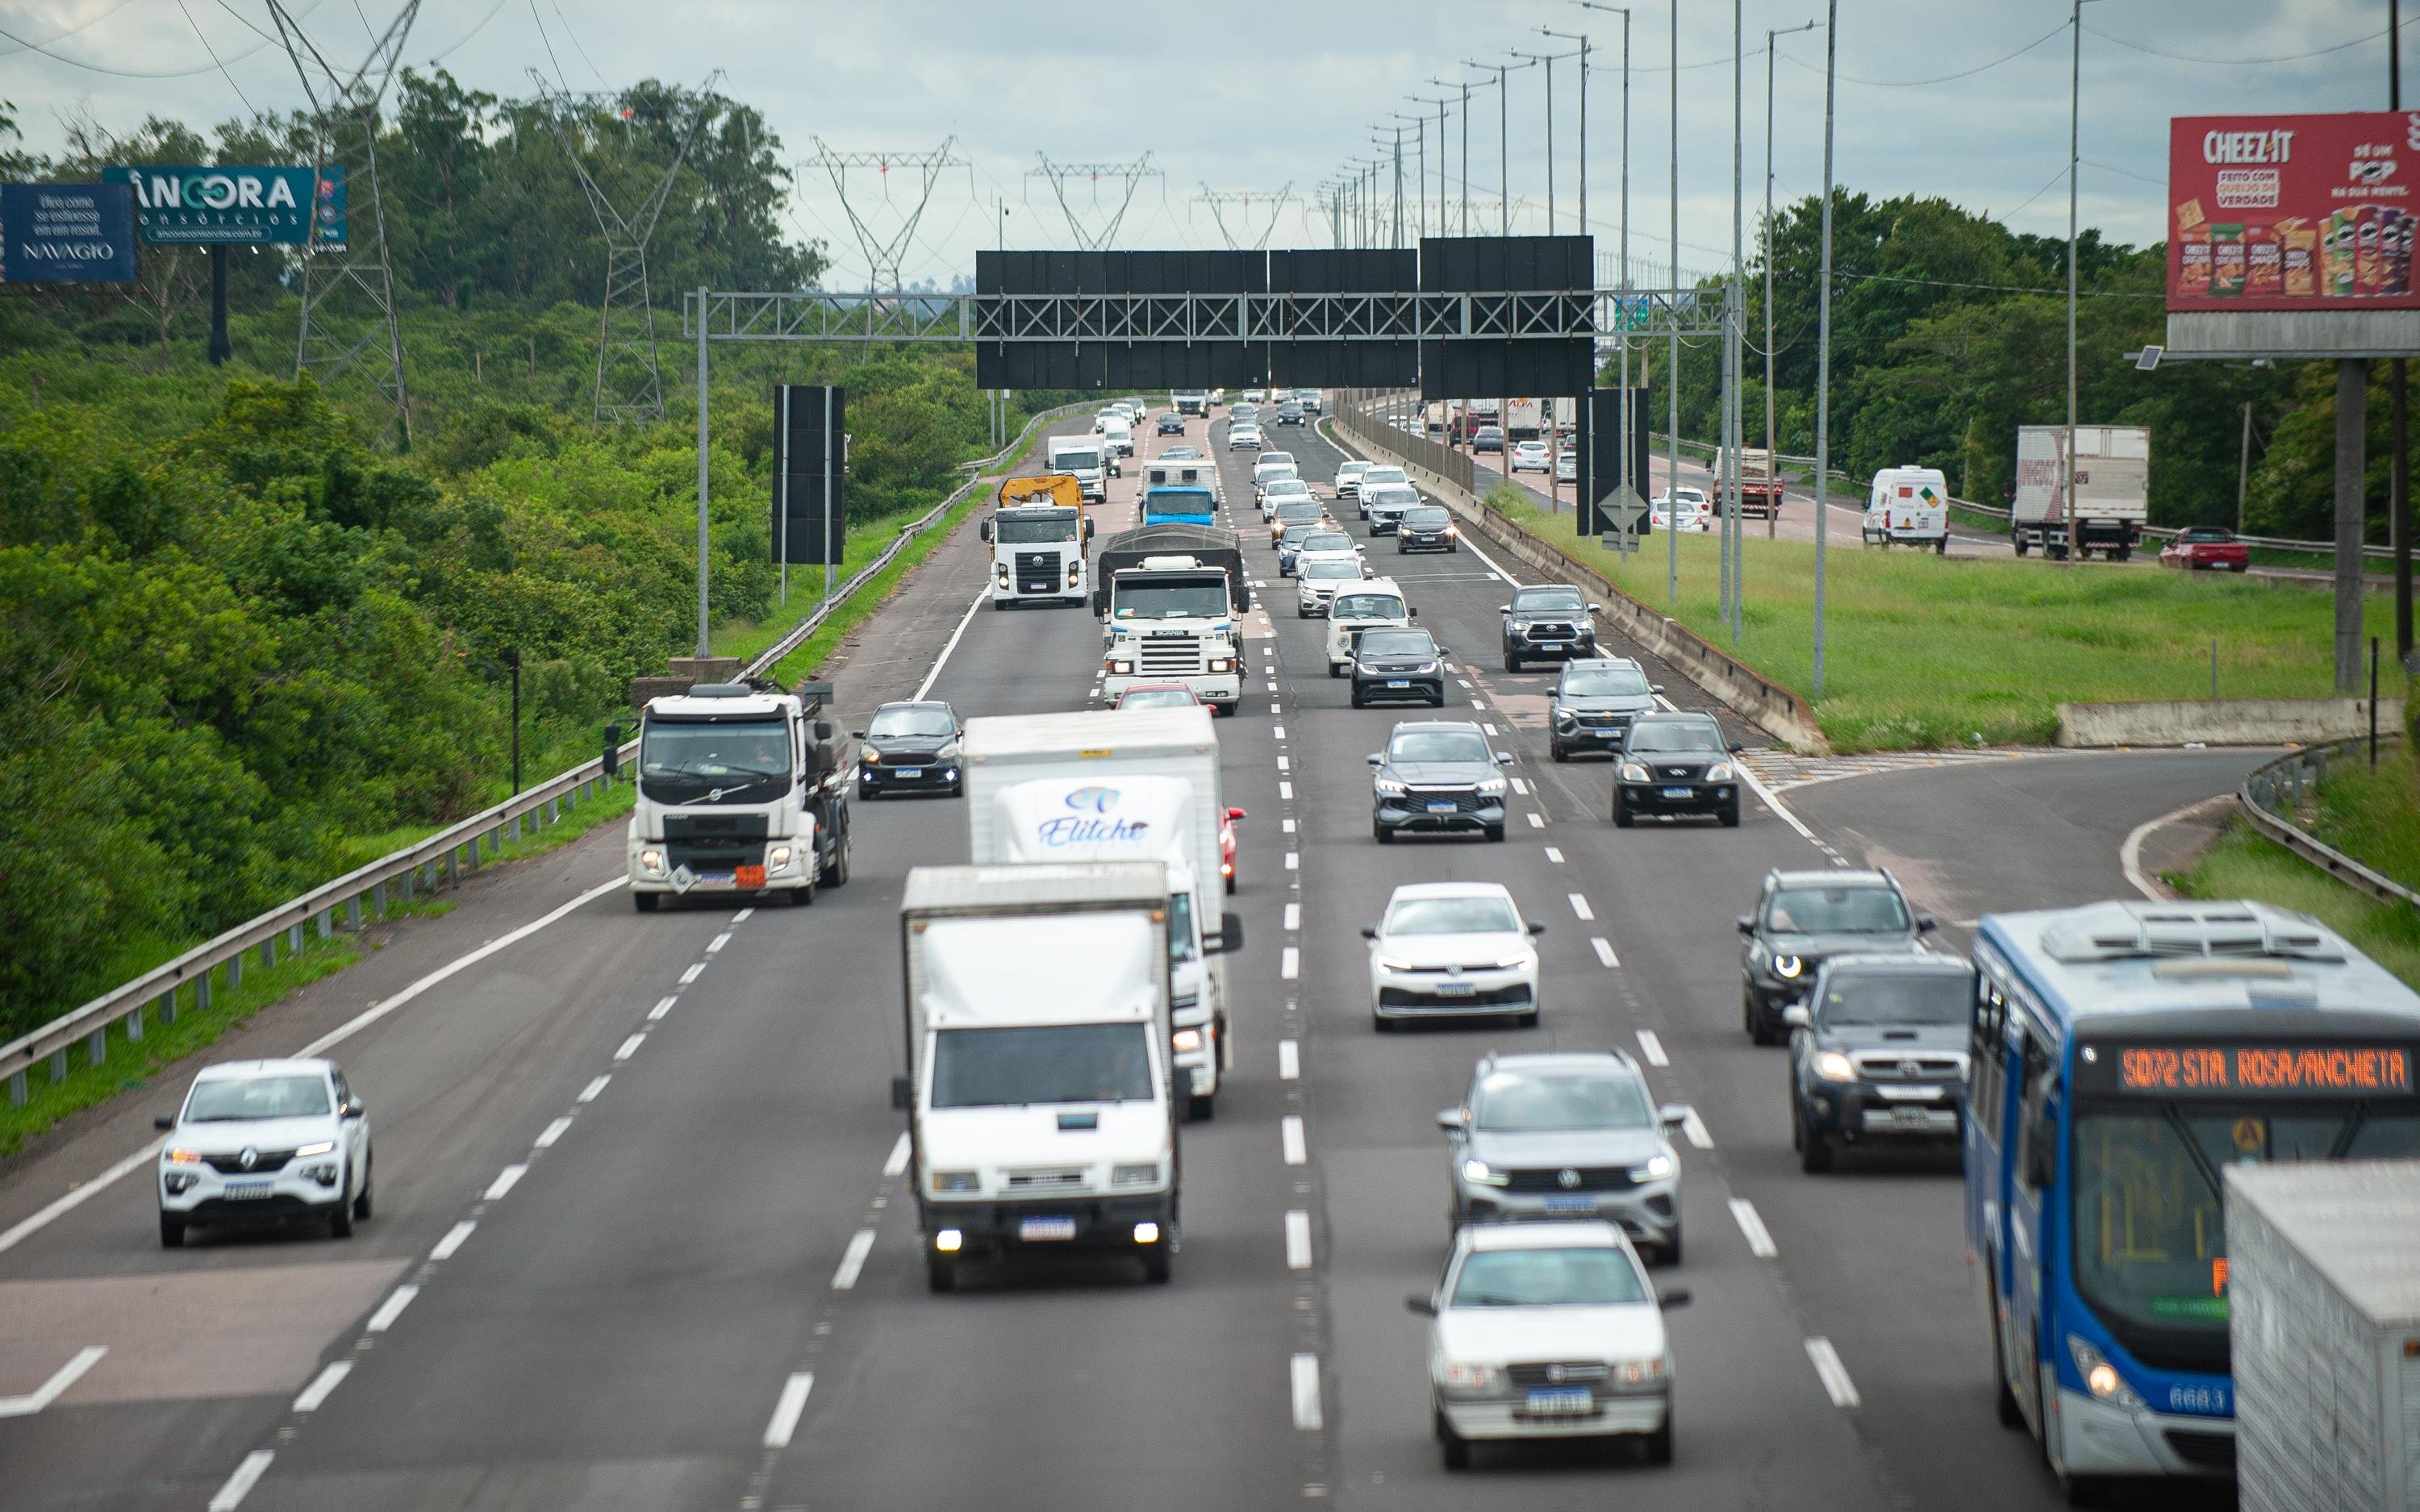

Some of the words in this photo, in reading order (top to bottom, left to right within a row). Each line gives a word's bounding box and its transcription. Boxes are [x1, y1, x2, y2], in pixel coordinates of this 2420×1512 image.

[2219, 195, 2275, 205] VERDADE
[22, 242, 114, 260] NAVAGIO
[2183, 1048, 2229, 1087] STA
